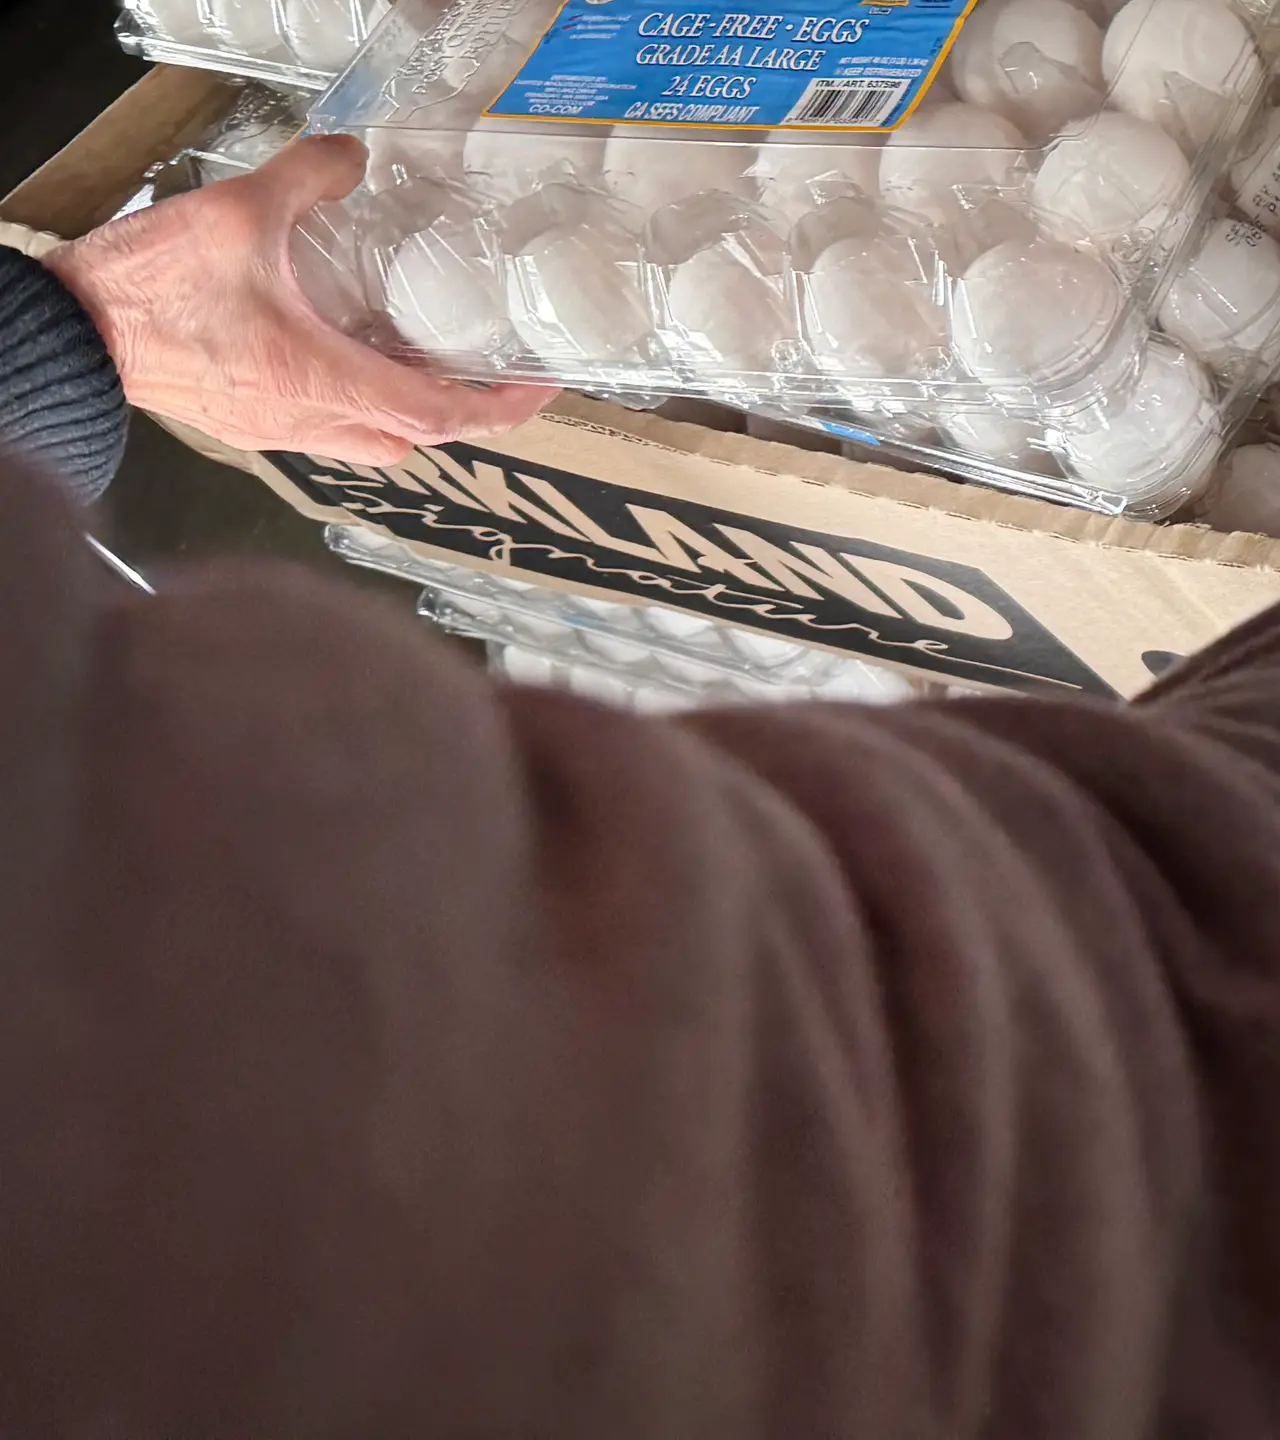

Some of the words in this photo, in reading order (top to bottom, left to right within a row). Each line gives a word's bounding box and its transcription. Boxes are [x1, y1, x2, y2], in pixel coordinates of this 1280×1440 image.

[638, 12, 783, 39] CAGE-FREE
[792, 19, 870, 43] EGGS
[635, 44, 709, 65] GRADE
[710, 44, 744, 66] AA
[745, 47, 827, 71] LARGE
[662, 74, 691, 97] 24
[689, 75, 757, 99] EGGS
[624, 102, 643, 118] CA
[645, 102, 682, 120] SEFS
[680, 103, 760, 124] COMPLIANT
